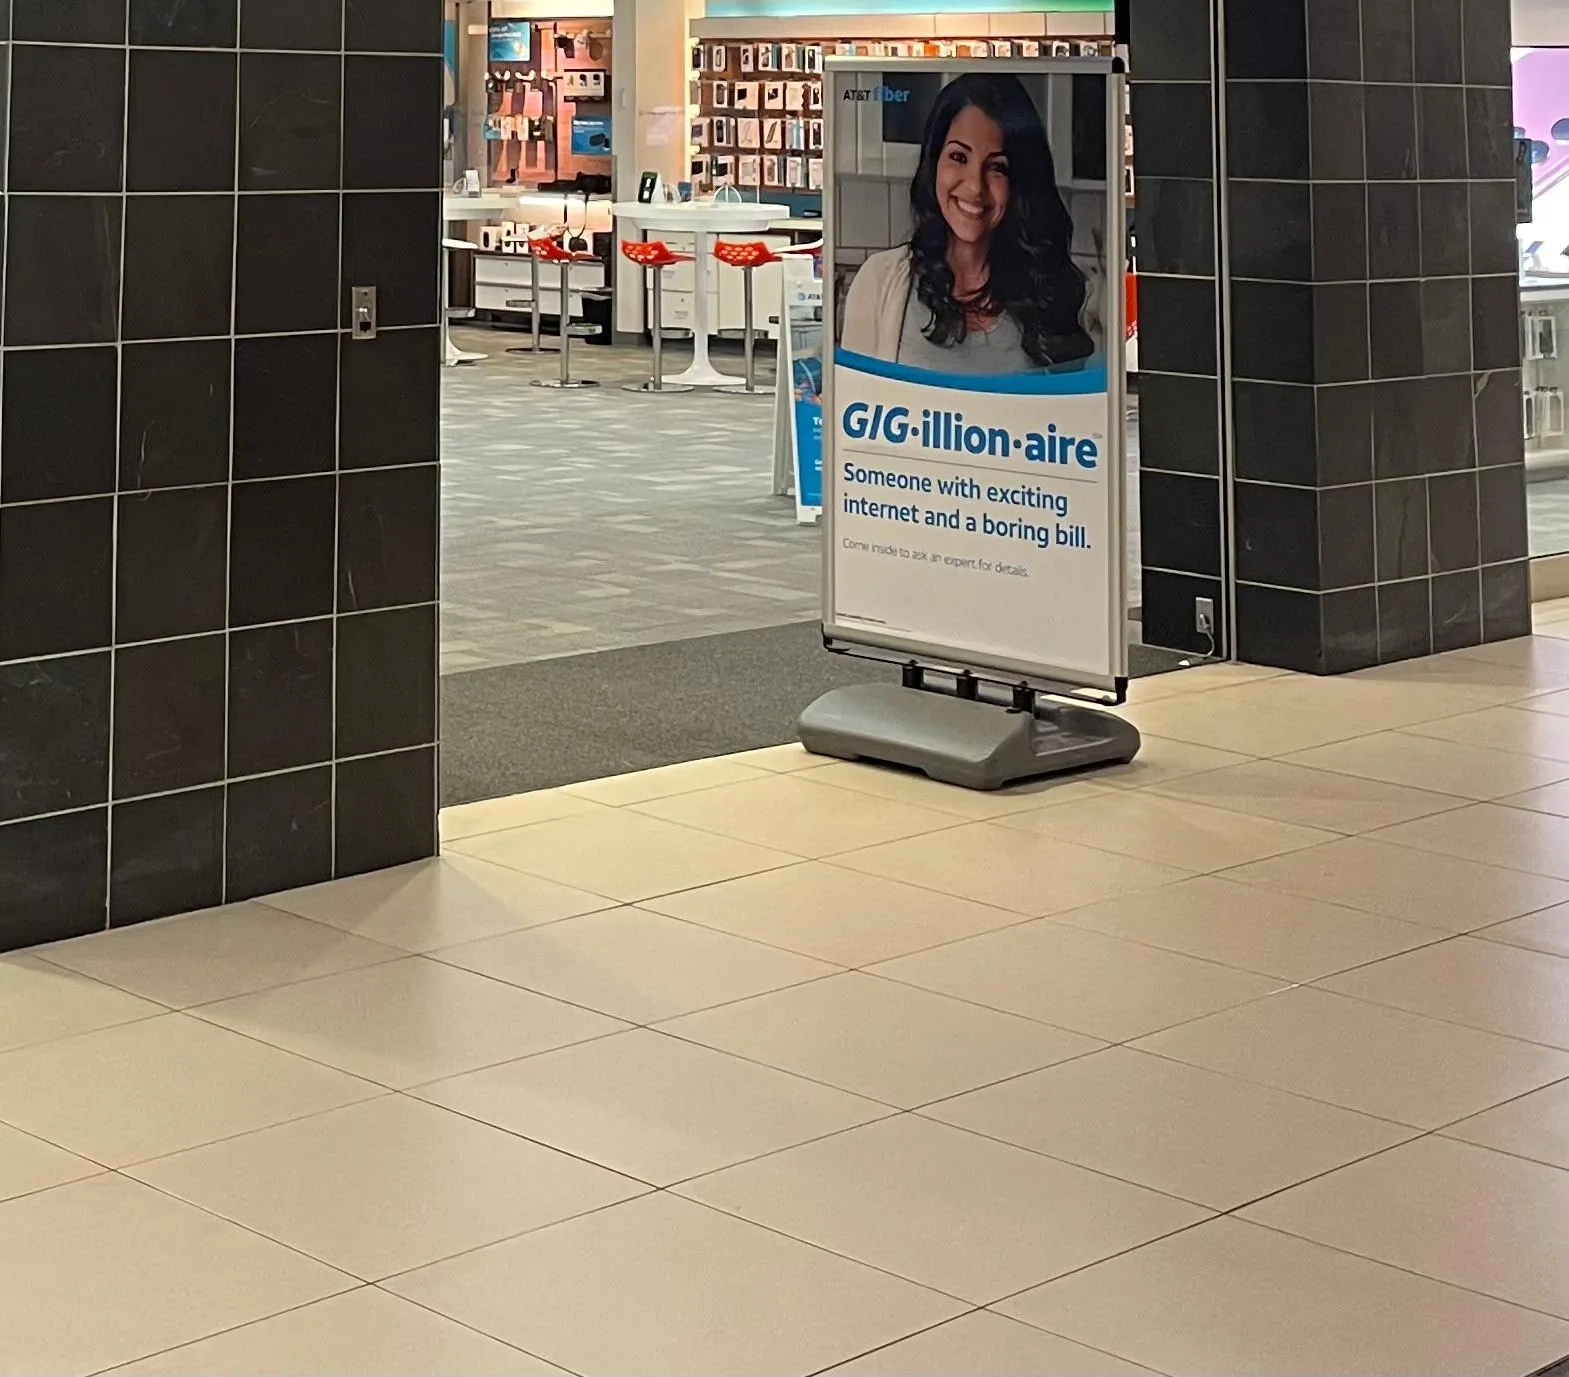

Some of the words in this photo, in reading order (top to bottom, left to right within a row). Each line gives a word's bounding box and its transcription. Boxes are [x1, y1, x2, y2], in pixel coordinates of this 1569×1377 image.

[843, 89, 871, 101] AT&T
[873, 84, 910, 102] fiber
[843, 462, 931, 492] Someone
[938, 476, 980, 500] with
[987, 485, 1068, 517] exciting
[843, 493, 919, 523] internet
[925, 509, 960, 529] and
[966, 515, 977, 532] a
[983, 513, 1049, 548] boring
[1056, 523, 1092, 549] bill.
[843, 537, 869, 551] Come
[871, 542, 897, 557] inside
[899, 548, 910, 559] to
[911, 549, 928, 561] ask
[931, 554, 942, 563] an
[944, 555, 976, 570] expert
[978, 558, 992, 572] for
